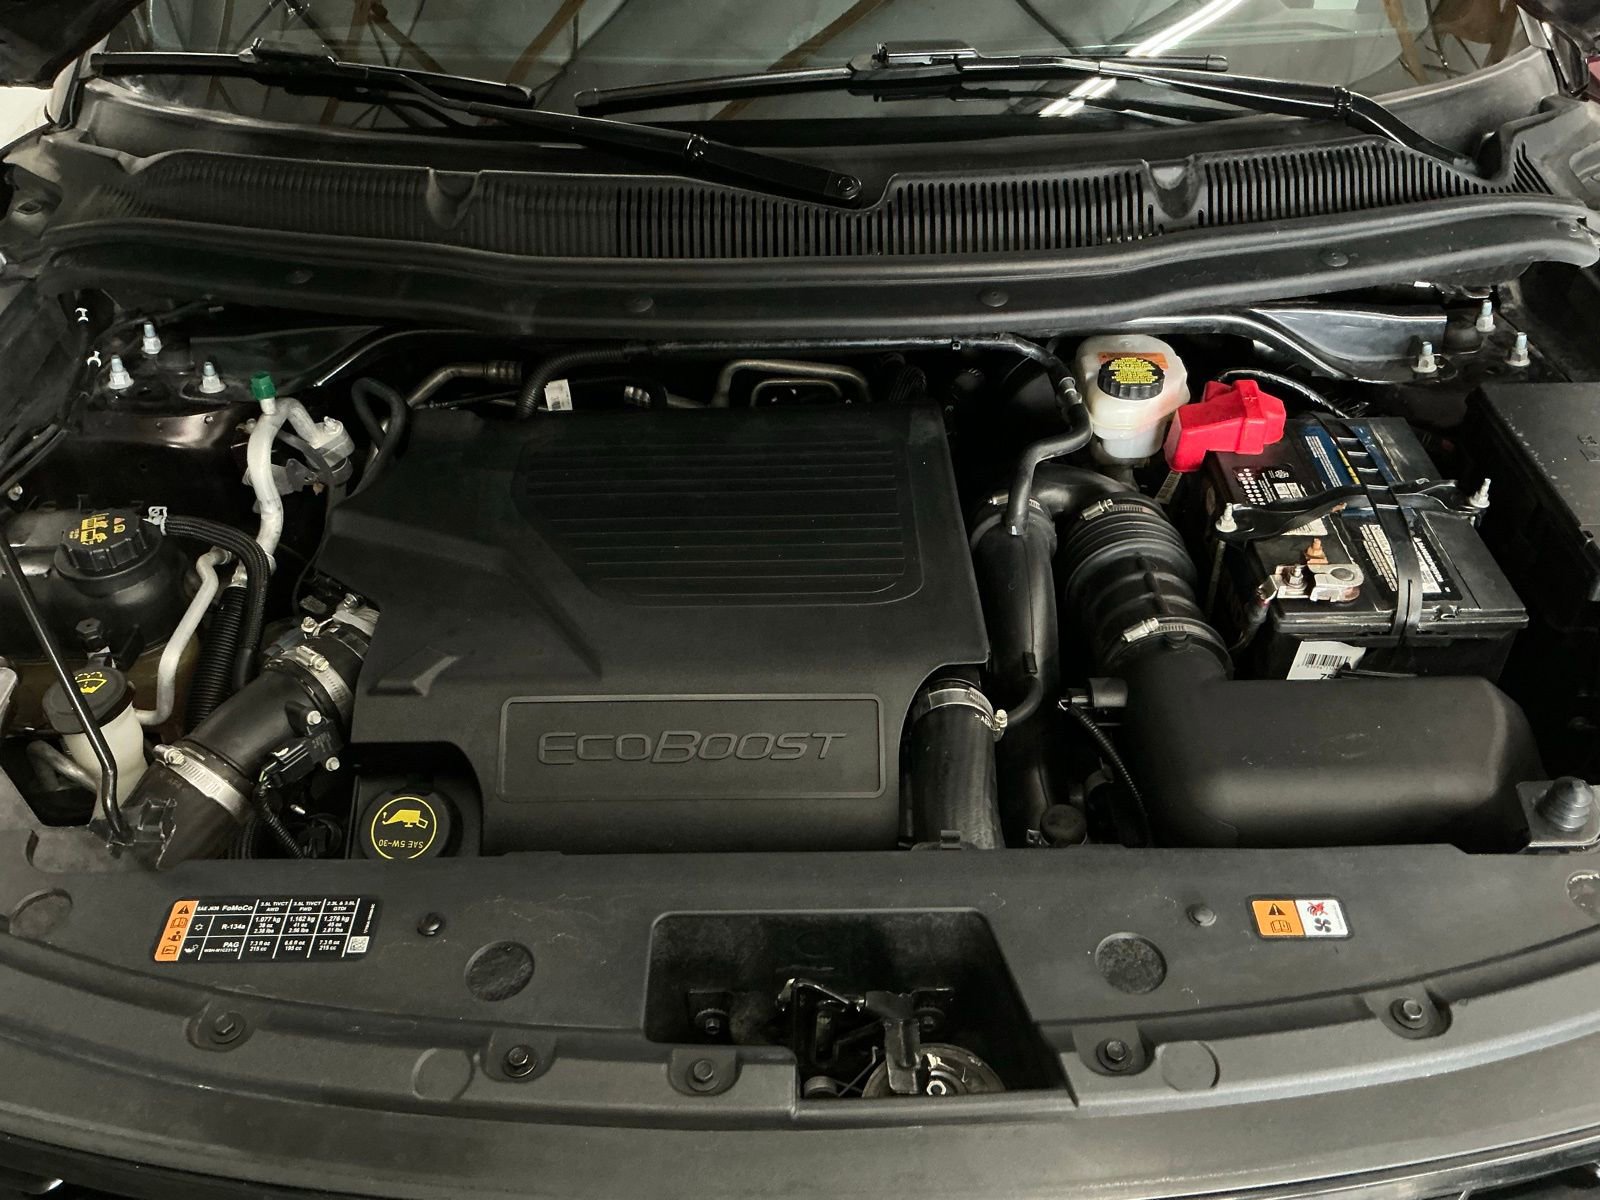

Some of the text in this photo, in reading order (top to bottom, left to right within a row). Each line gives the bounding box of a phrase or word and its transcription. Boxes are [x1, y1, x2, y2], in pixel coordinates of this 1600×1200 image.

[378, 839, 424, 849] SAE 5W-30
[341, 915, 350, 923] kg
